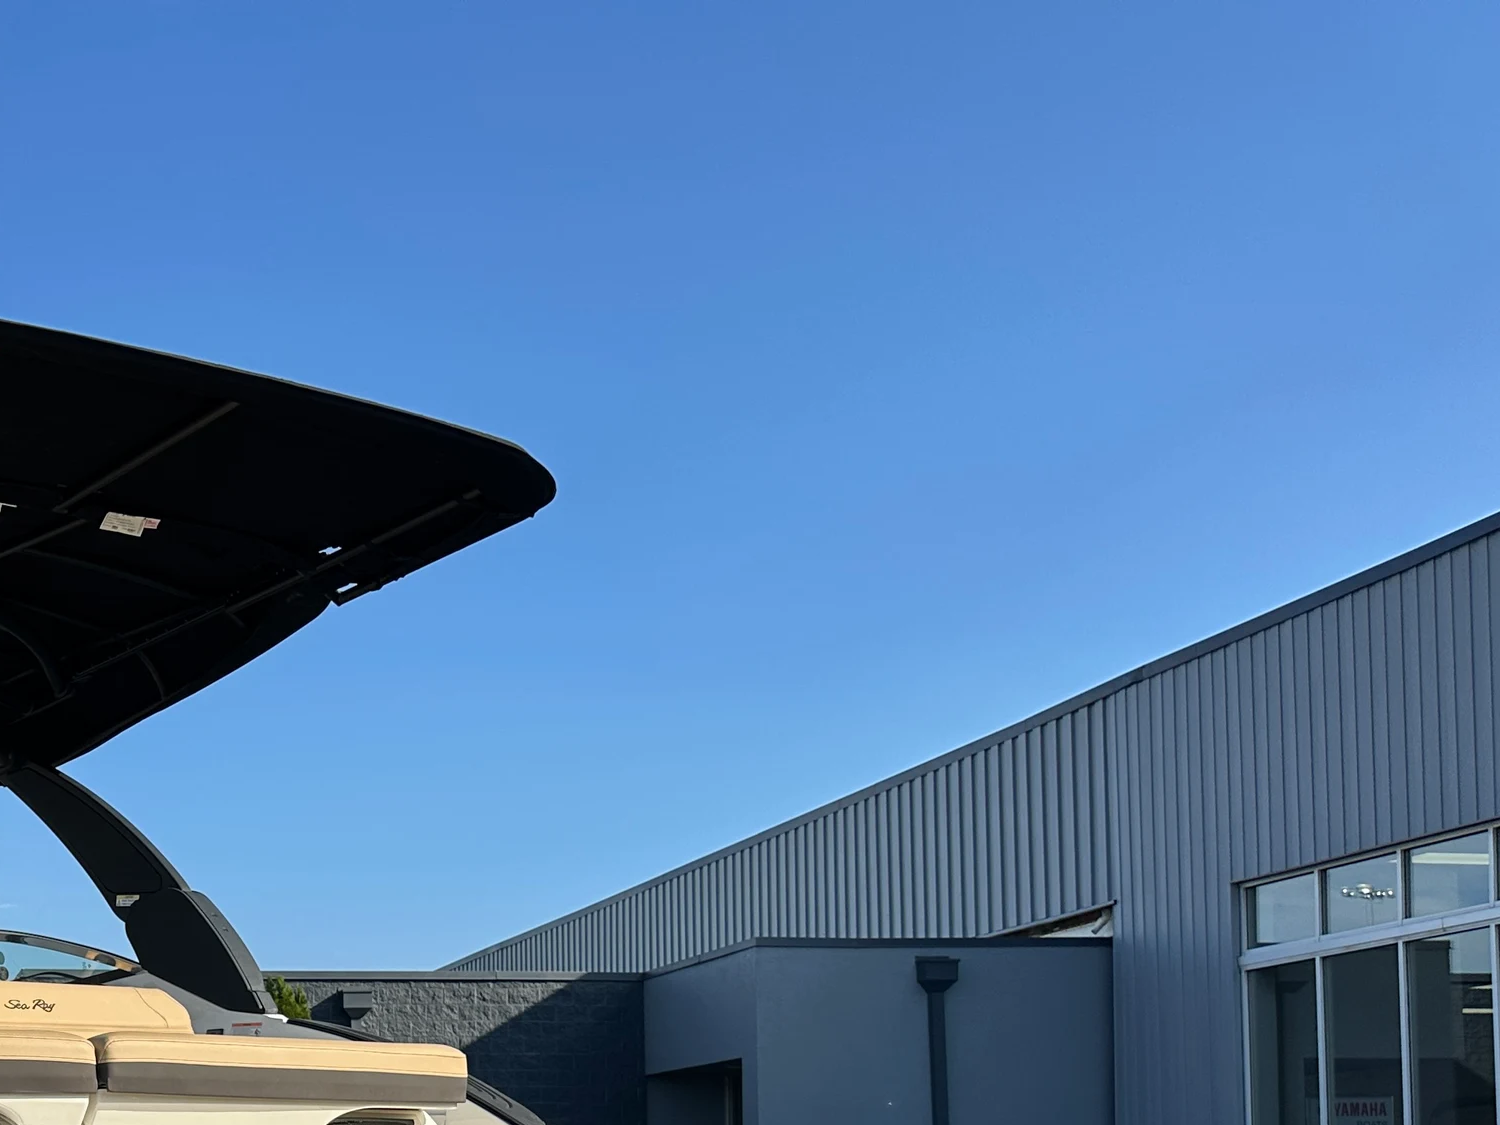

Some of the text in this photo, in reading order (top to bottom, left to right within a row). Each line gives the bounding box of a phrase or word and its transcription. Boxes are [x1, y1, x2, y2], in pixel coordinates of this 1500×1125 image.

[3, 998, 56, 1013] Sea Ray
[1334, 1102, 1388, 1117] YAMAHA
